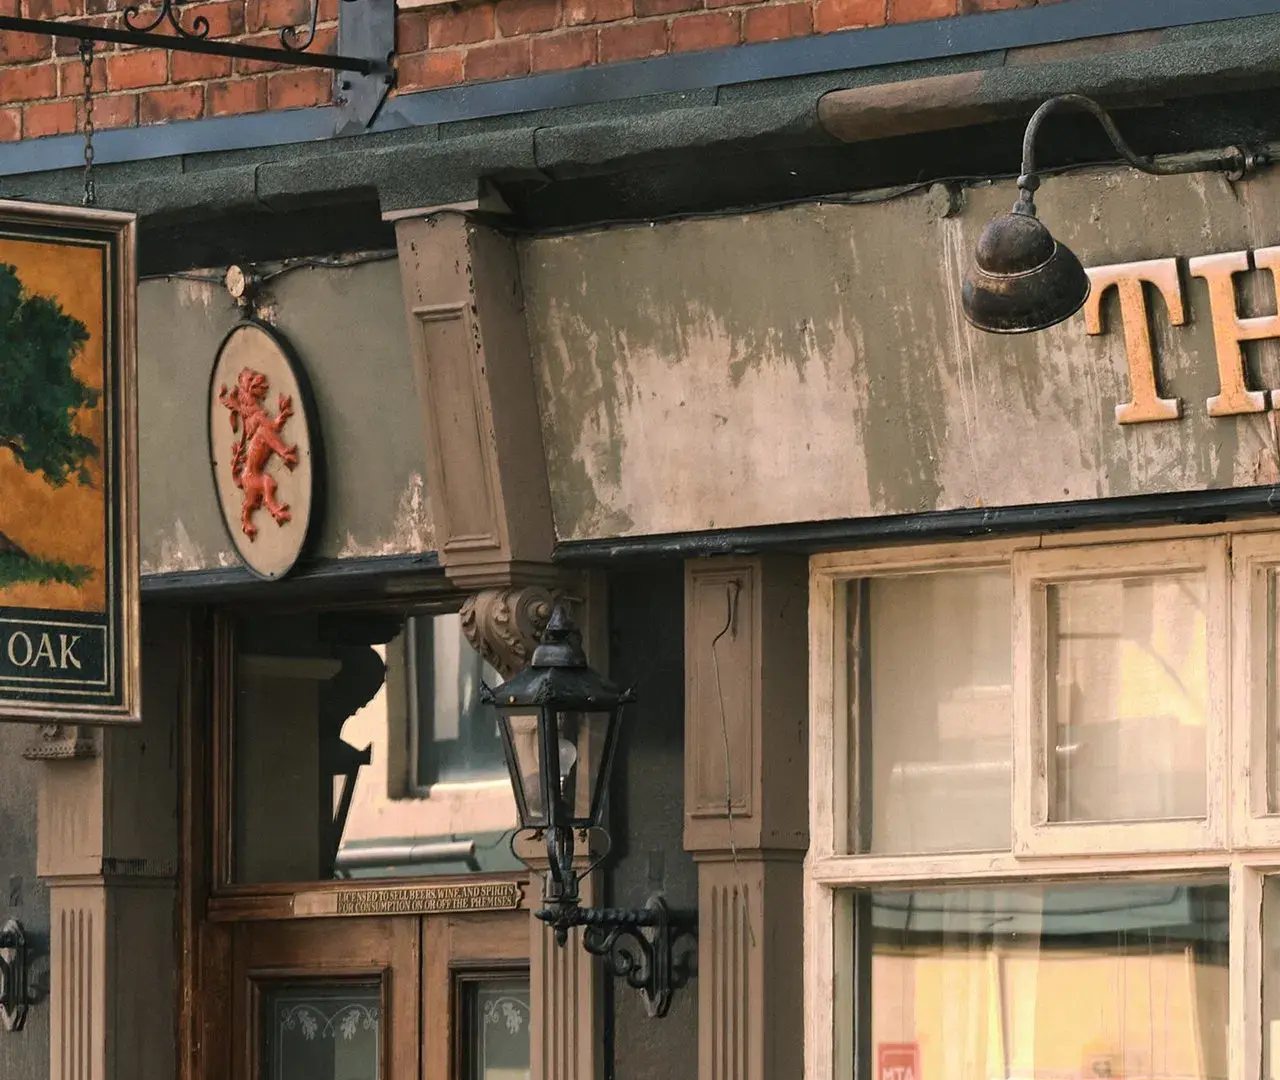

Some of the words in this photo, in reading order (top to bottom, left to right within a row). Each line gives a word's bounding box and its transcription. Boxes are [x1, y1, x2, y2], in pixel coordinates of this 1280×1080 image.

[7, 630, 82, 670] OAK
[378, 890, 388, 902] TO
[388, 888, 409, 901] SELL
[461, 886, 479, 898] AND
[480, 885, 514, 897] SPIRITS
[354, 900, 411, 914] CONSUMPTION
[411, 899, 423, 911] ON
[424, 899, 436, 911] OR
[436, 898, 451, 910] OFF
[453, 897, 469, 909] THE
